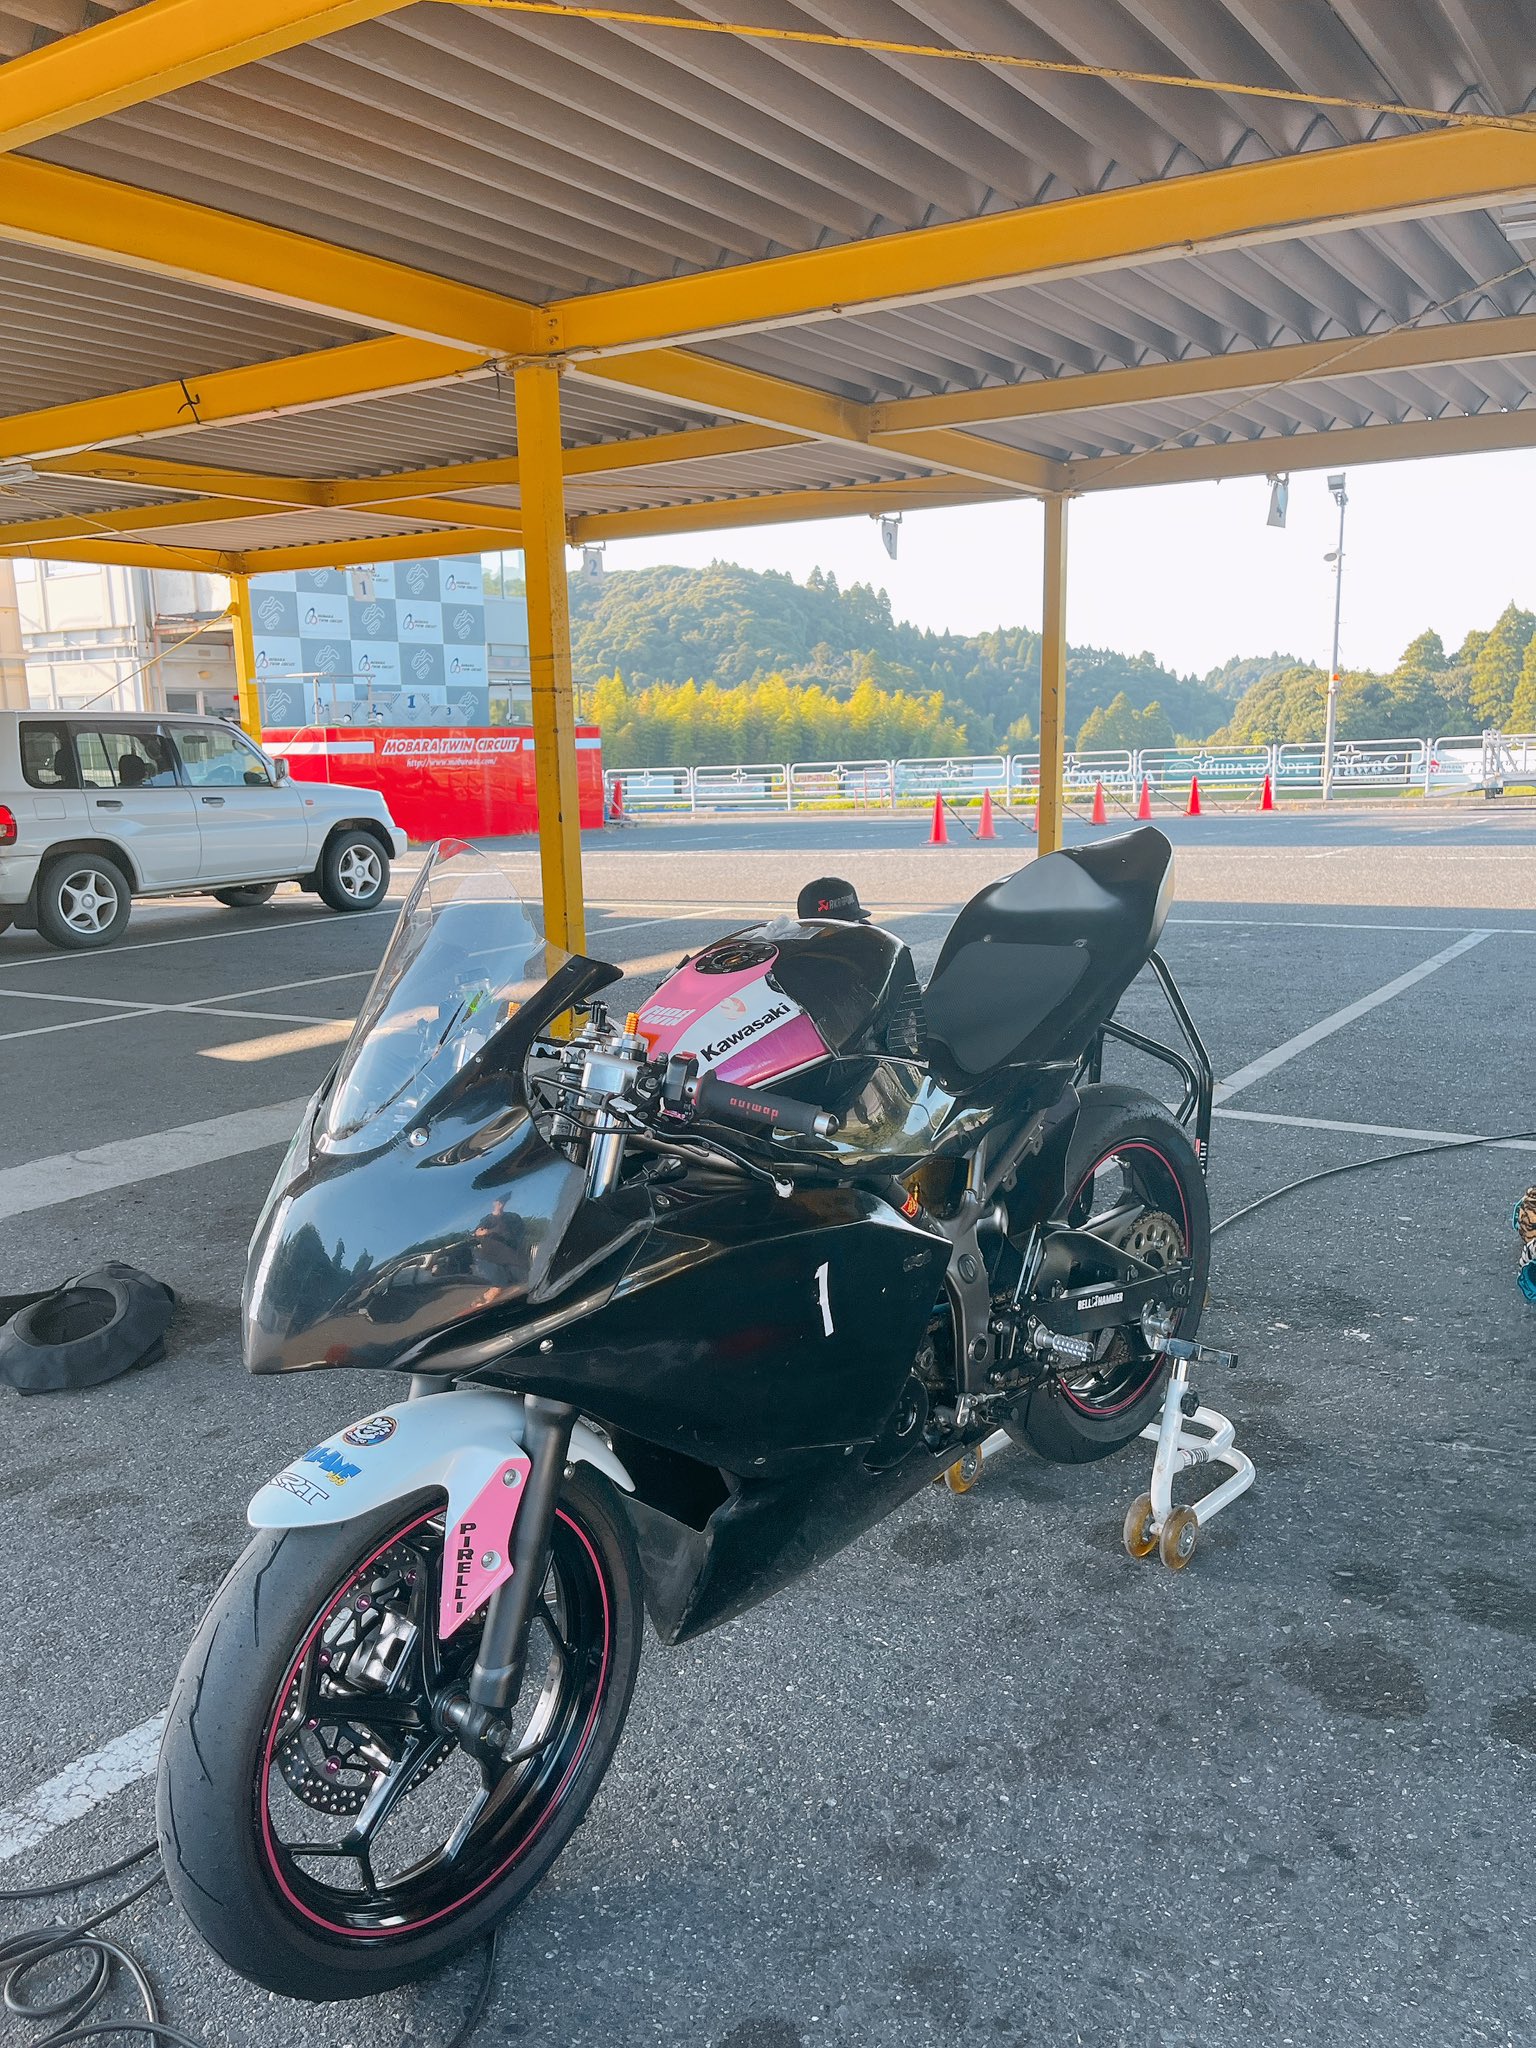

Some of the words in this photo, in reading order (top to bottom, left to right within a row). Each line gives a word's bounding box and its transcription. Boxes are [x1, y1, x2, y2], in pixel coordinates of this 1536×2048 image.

[589, 559, 598, 576] 2
[360, 581, 367, 595] 1
[407, 695, 416, 709] 1
[383, 739, 440, 755] MOBARA
[440, 738, 474, 753] TWIN
[476, 737, 519, 752] CIRCUIT
[700, 1002, 791, 1063] Kawasaki
[729, 1097, 779, 1122] domino
[814, 1261, 835, 1338] 1
[454, 1522, 477, 1614] PIRELLI
